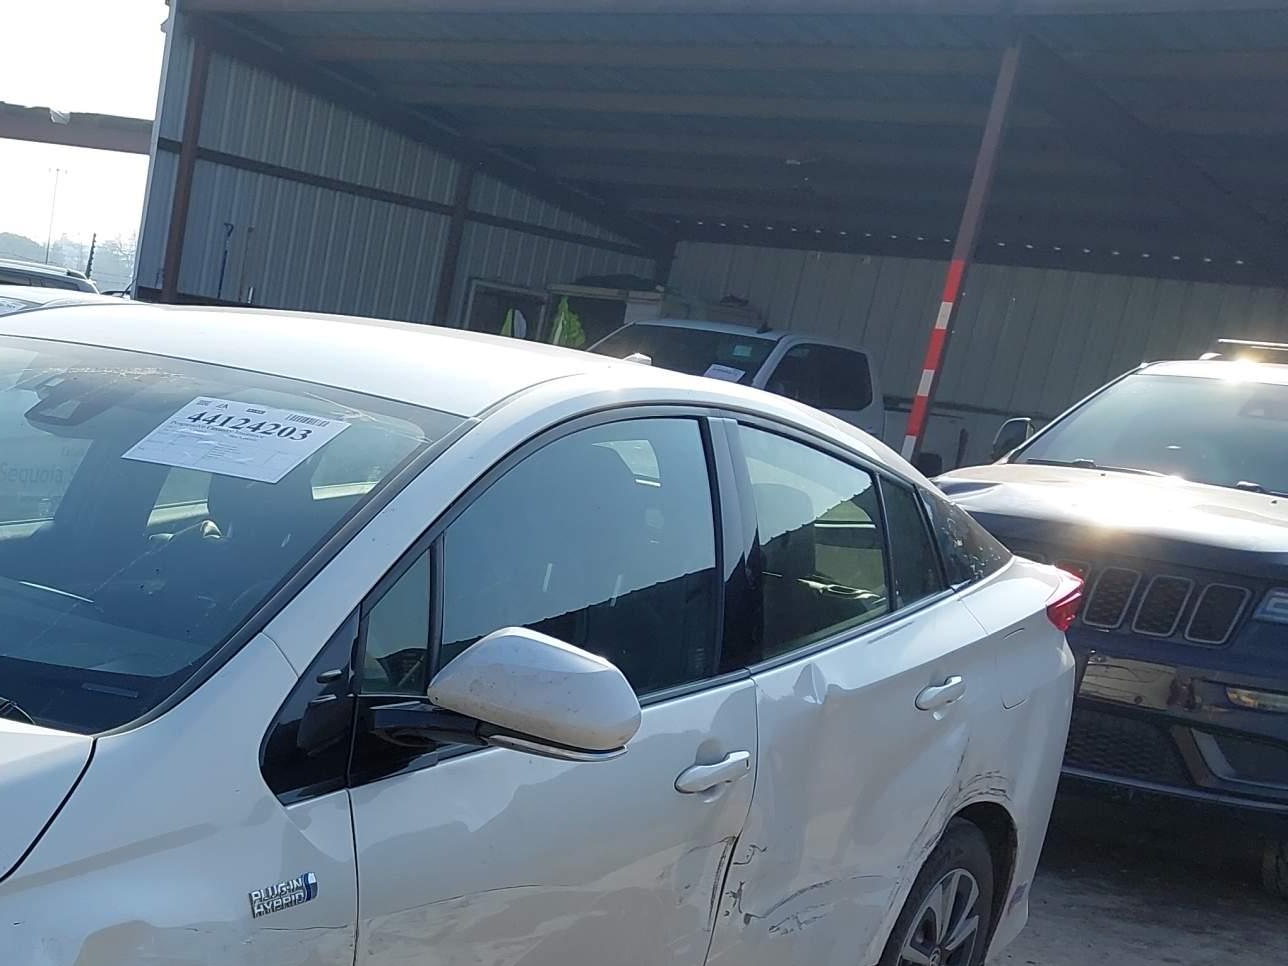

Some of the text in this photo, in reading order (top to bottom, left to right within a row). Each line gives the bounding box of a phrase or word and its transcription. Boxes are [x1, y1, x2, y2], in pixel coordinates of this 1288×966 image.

[187, 411, 313, 441] 44124203
[0, 462, 64, 487] Sequoia
[254, 889, 305, 917] HYBRID
